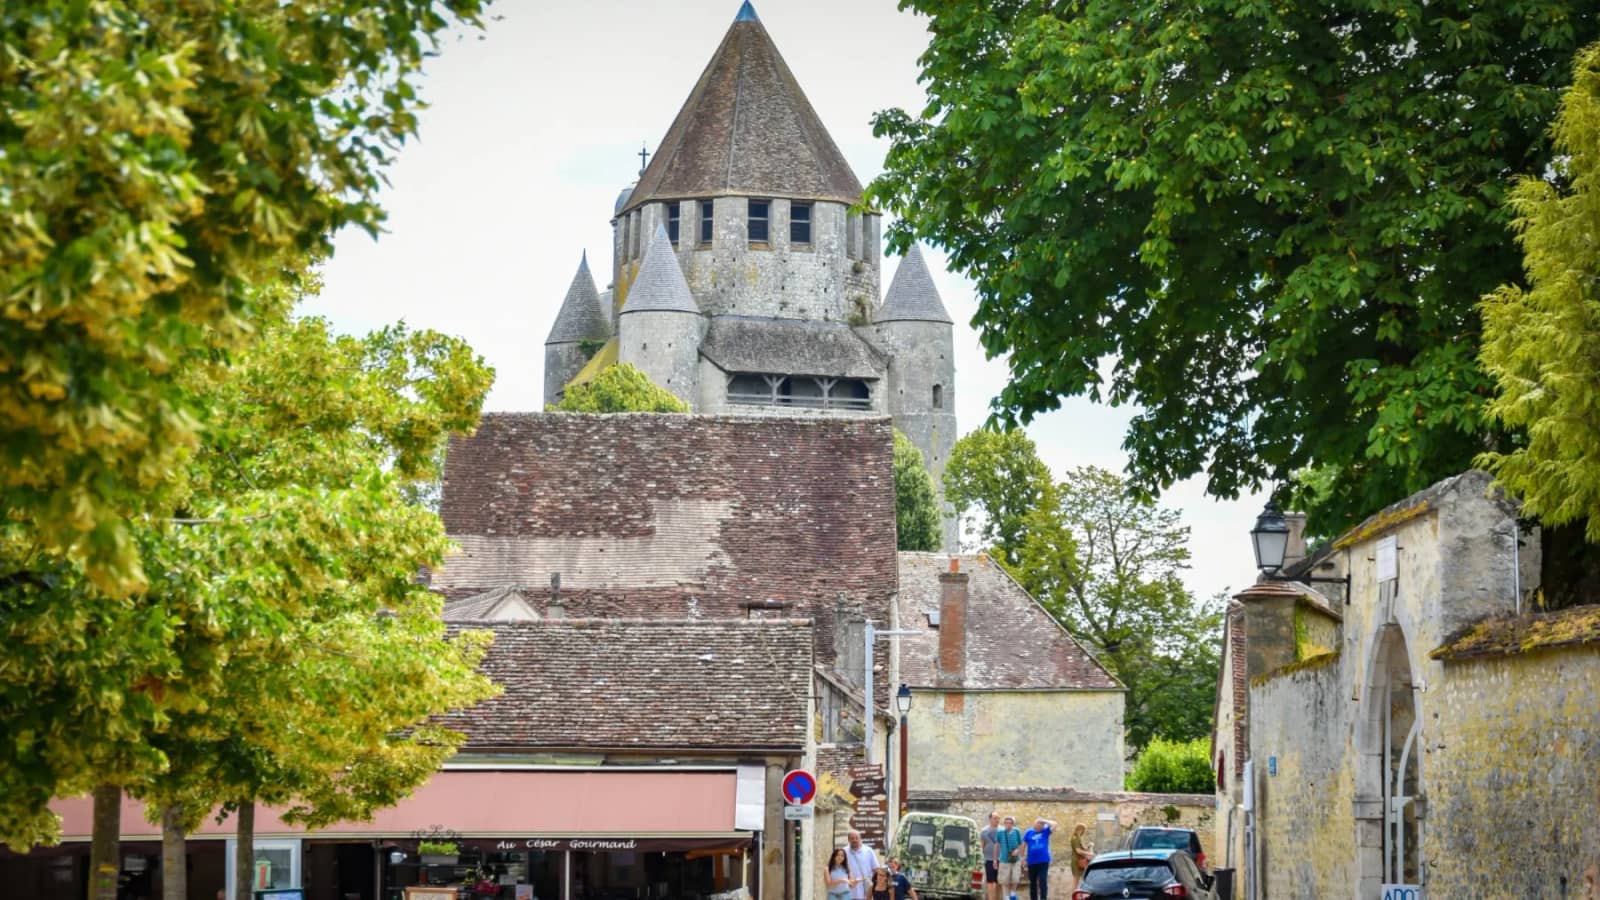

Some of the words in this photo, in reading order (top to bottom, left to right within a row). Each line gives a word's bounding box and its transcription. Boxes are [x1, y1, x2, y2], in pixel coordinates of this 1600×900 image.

[496, 840, 516, 849] Au
[525, 839, 561, 849] César
[569, 839, 637, 849] Gourmand
[1384, 888, 1421, 900] ADO
